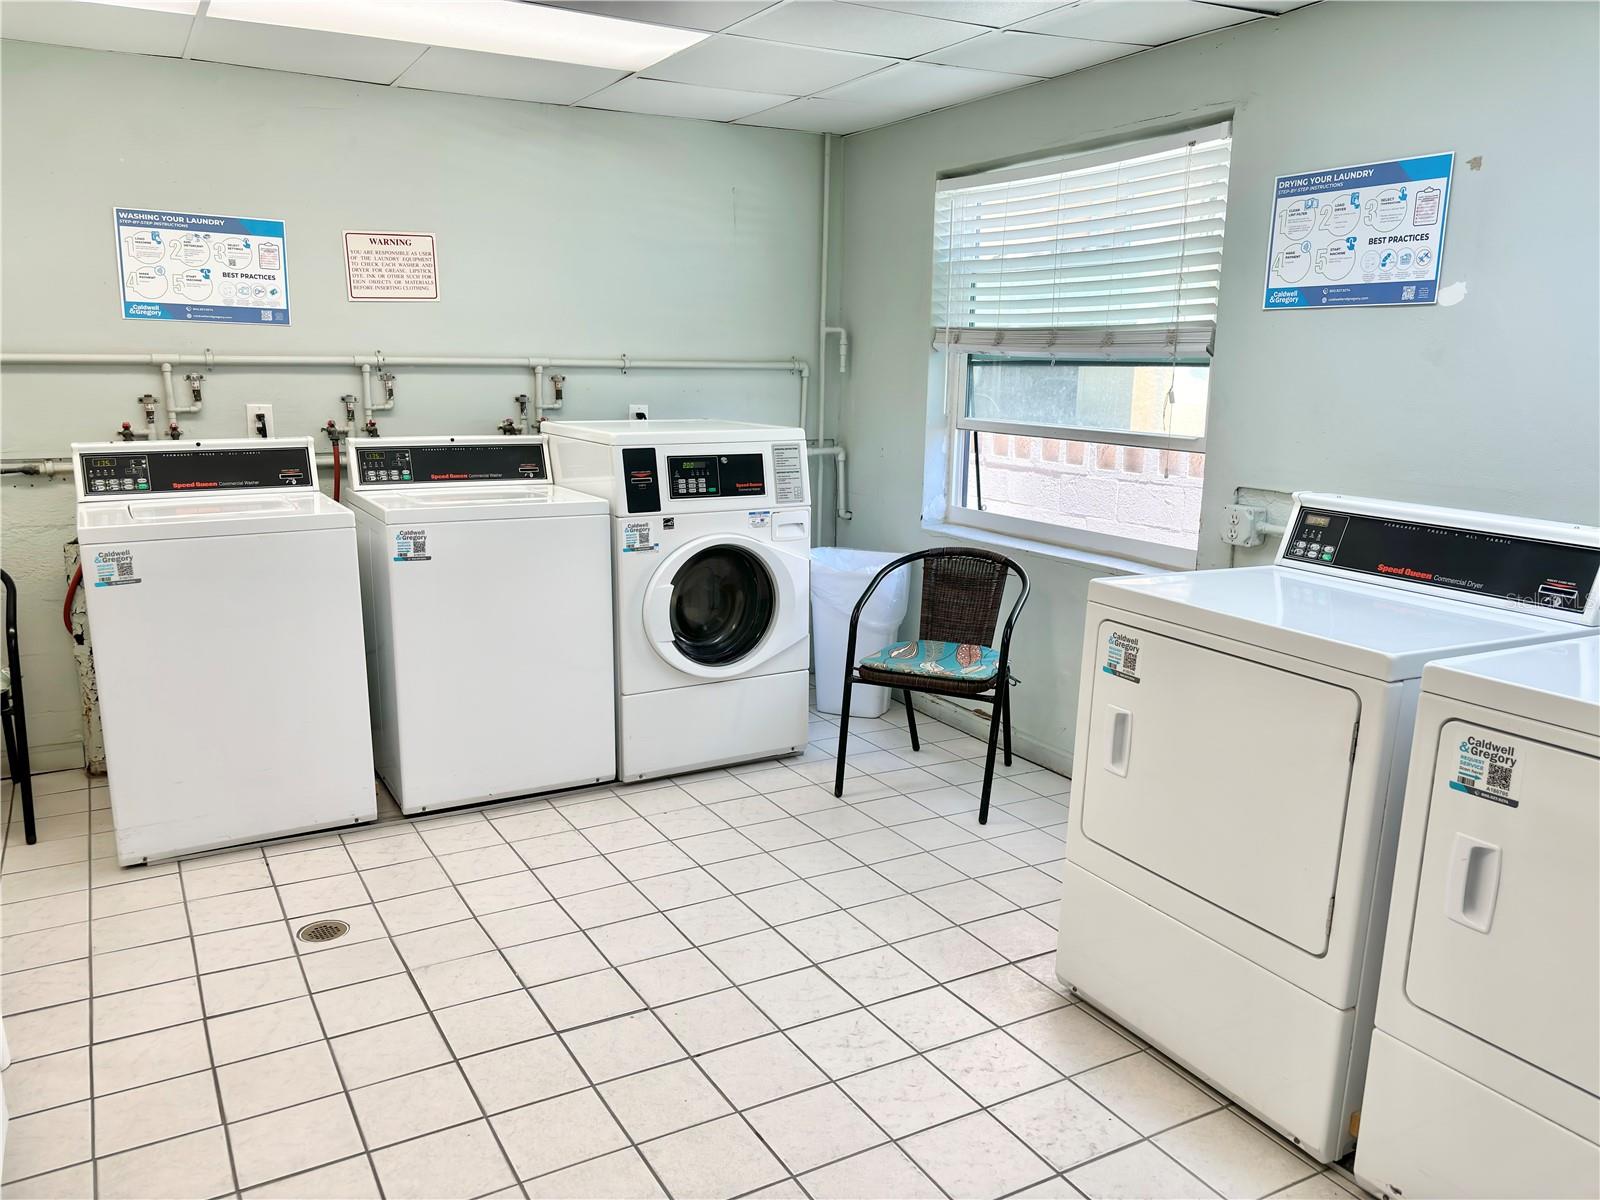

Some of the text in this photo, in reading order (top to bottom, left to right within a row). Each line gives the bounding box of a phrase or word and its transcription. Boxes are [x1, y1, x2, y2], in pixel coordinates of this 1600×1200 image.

[1279, 169, 1374, 189] DRYING YOUR LAUNDRY
[1310, 182, 1343, 191] INSTRUCTIONS
[118, 212, 160, 221] WASHING
[186, 218, 225, 226] LAUNDRY
[369, 238, 412, 246] WARNING
[1368, 233, 1430, 245] BEST PRACTICES
[240, 273, 276, 281] PRACTICES
[98, 549, 131, 558] Caldwell
[1377, 563, 1484, 589] Speed Queen Commercial Dryer
[1112, 632, 1139, 646] Caldwell
[1467, 736, 1515, 756] Caldwell
